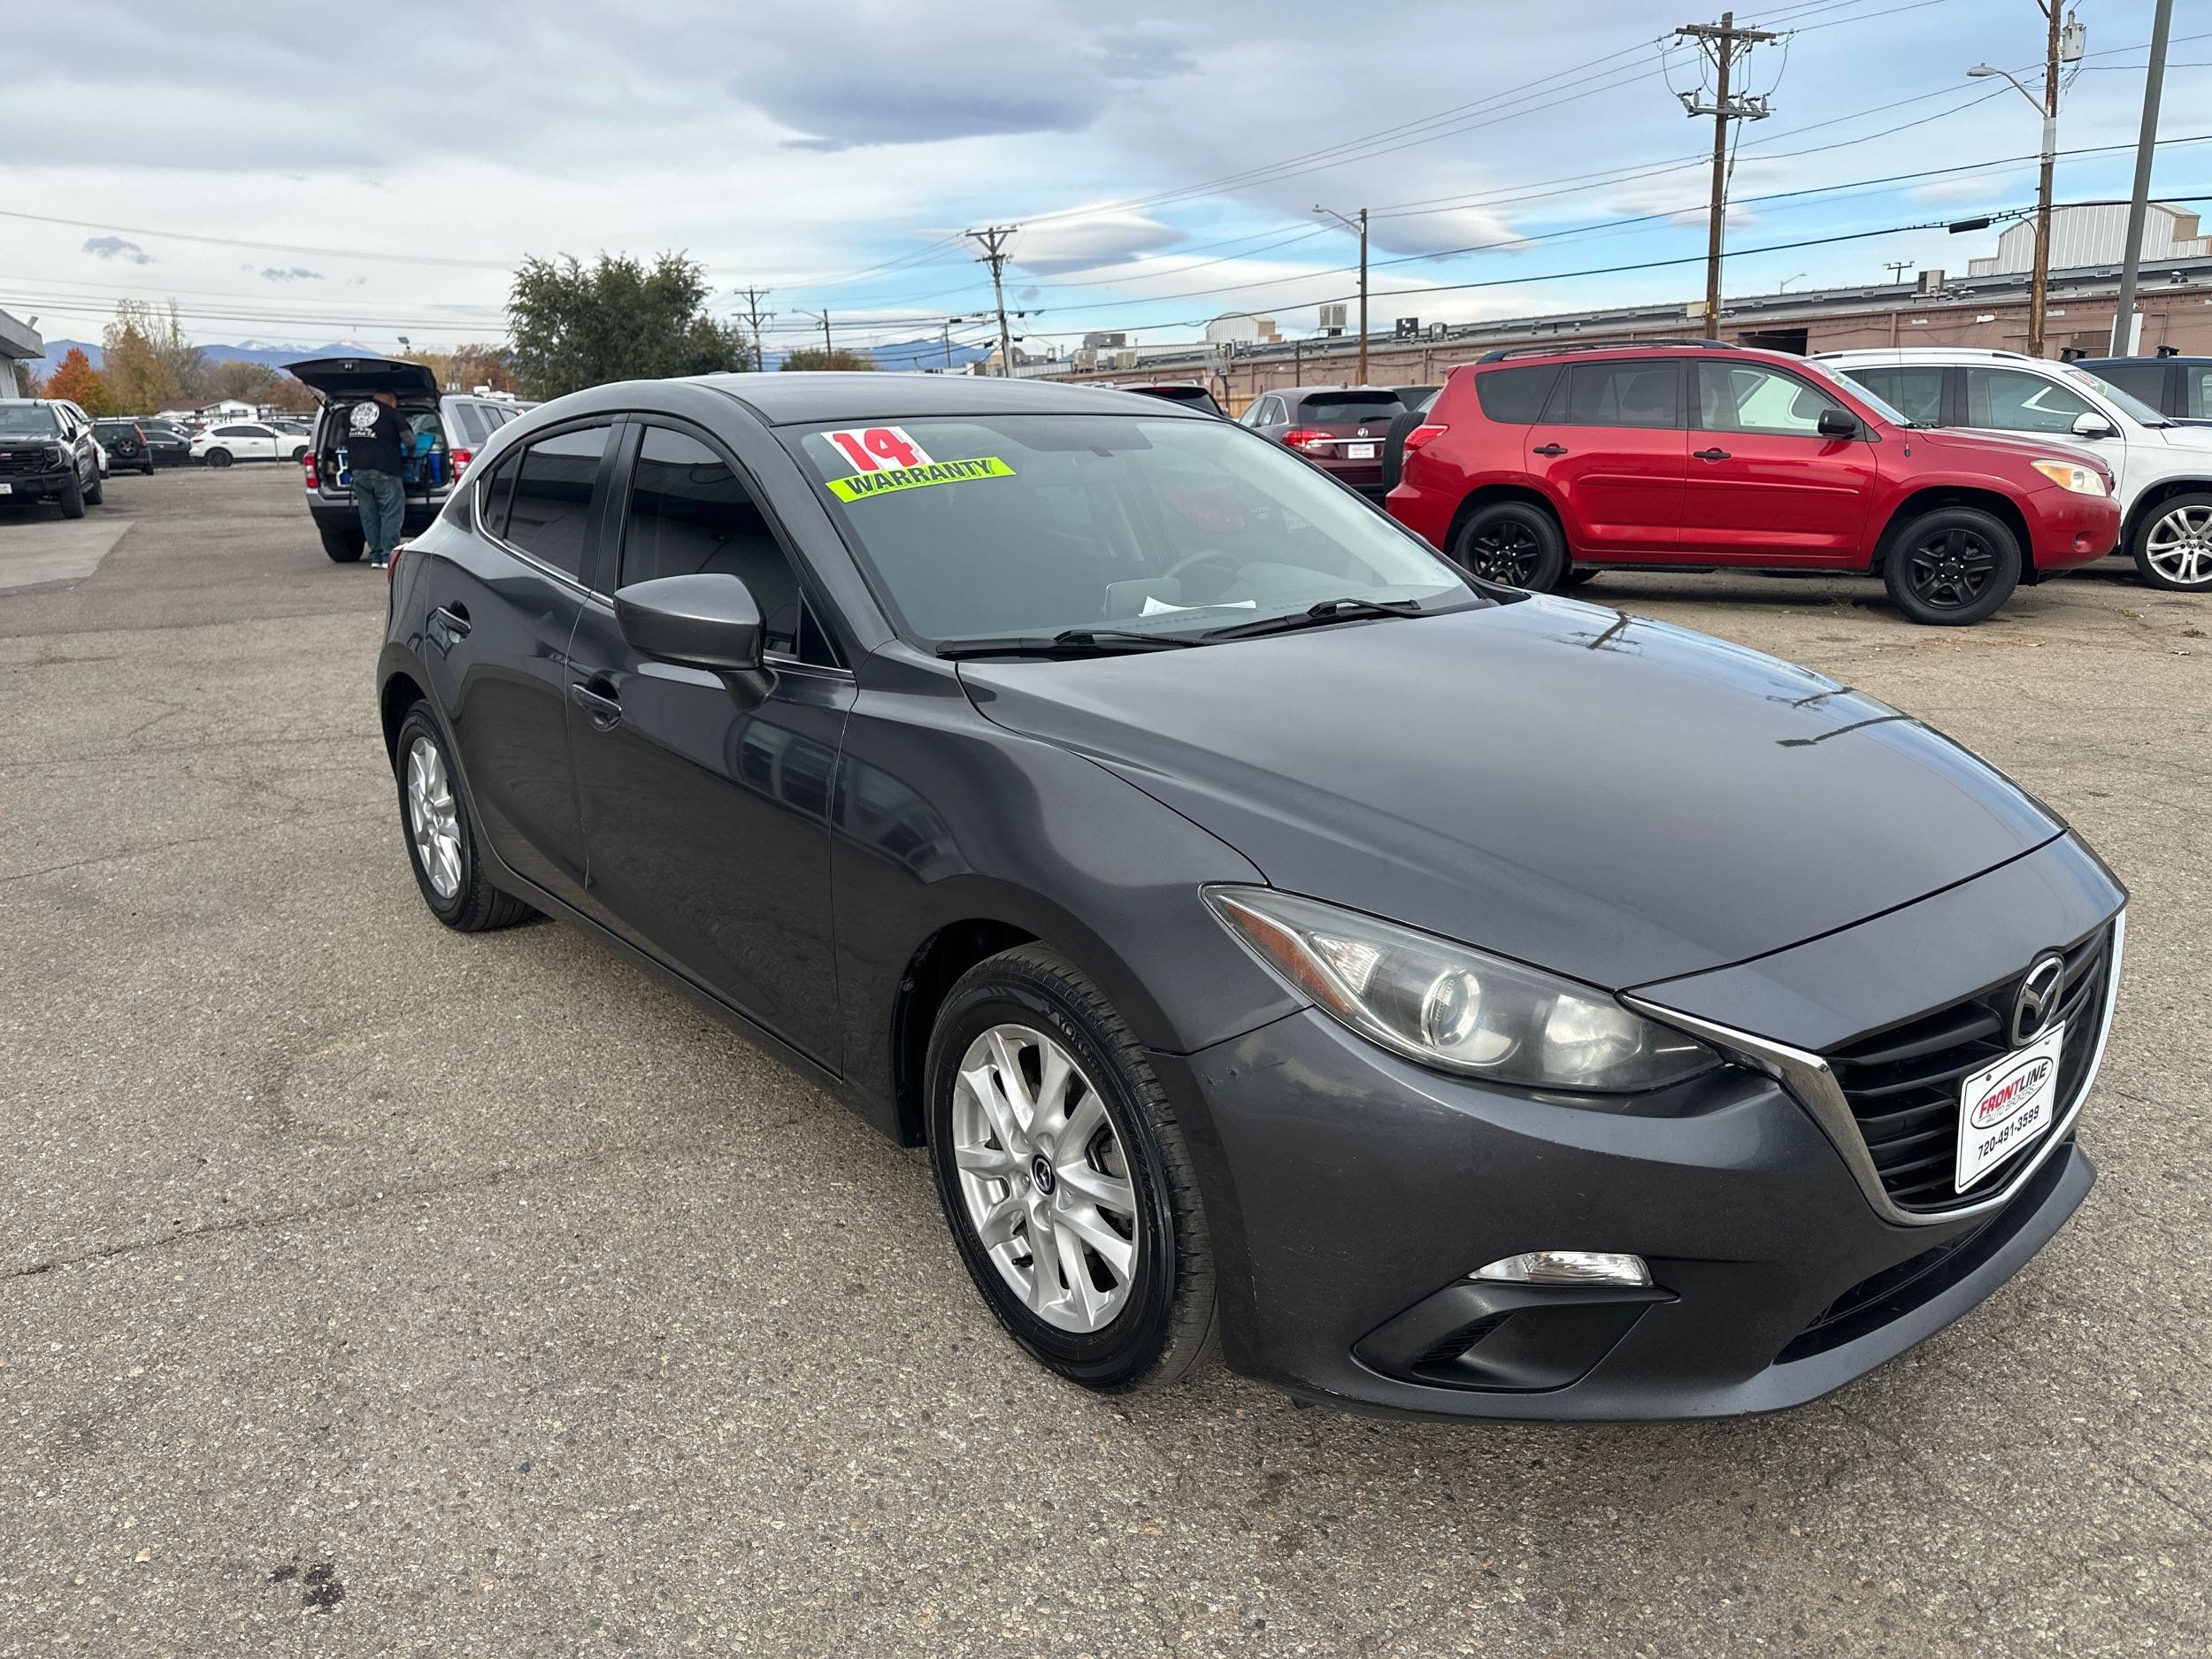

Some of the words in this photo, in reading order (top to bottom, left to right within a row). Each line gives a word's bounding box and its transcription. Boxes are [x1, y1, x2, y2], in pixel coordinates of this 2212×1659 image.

[833, 429, 919, 472] 14
[844, 459, 992, 495] WARRANTY
[1978, 1061, 2049, 1120] FRONTLINE
[1978, 1105, 2039, 1160] 720-491-3599
